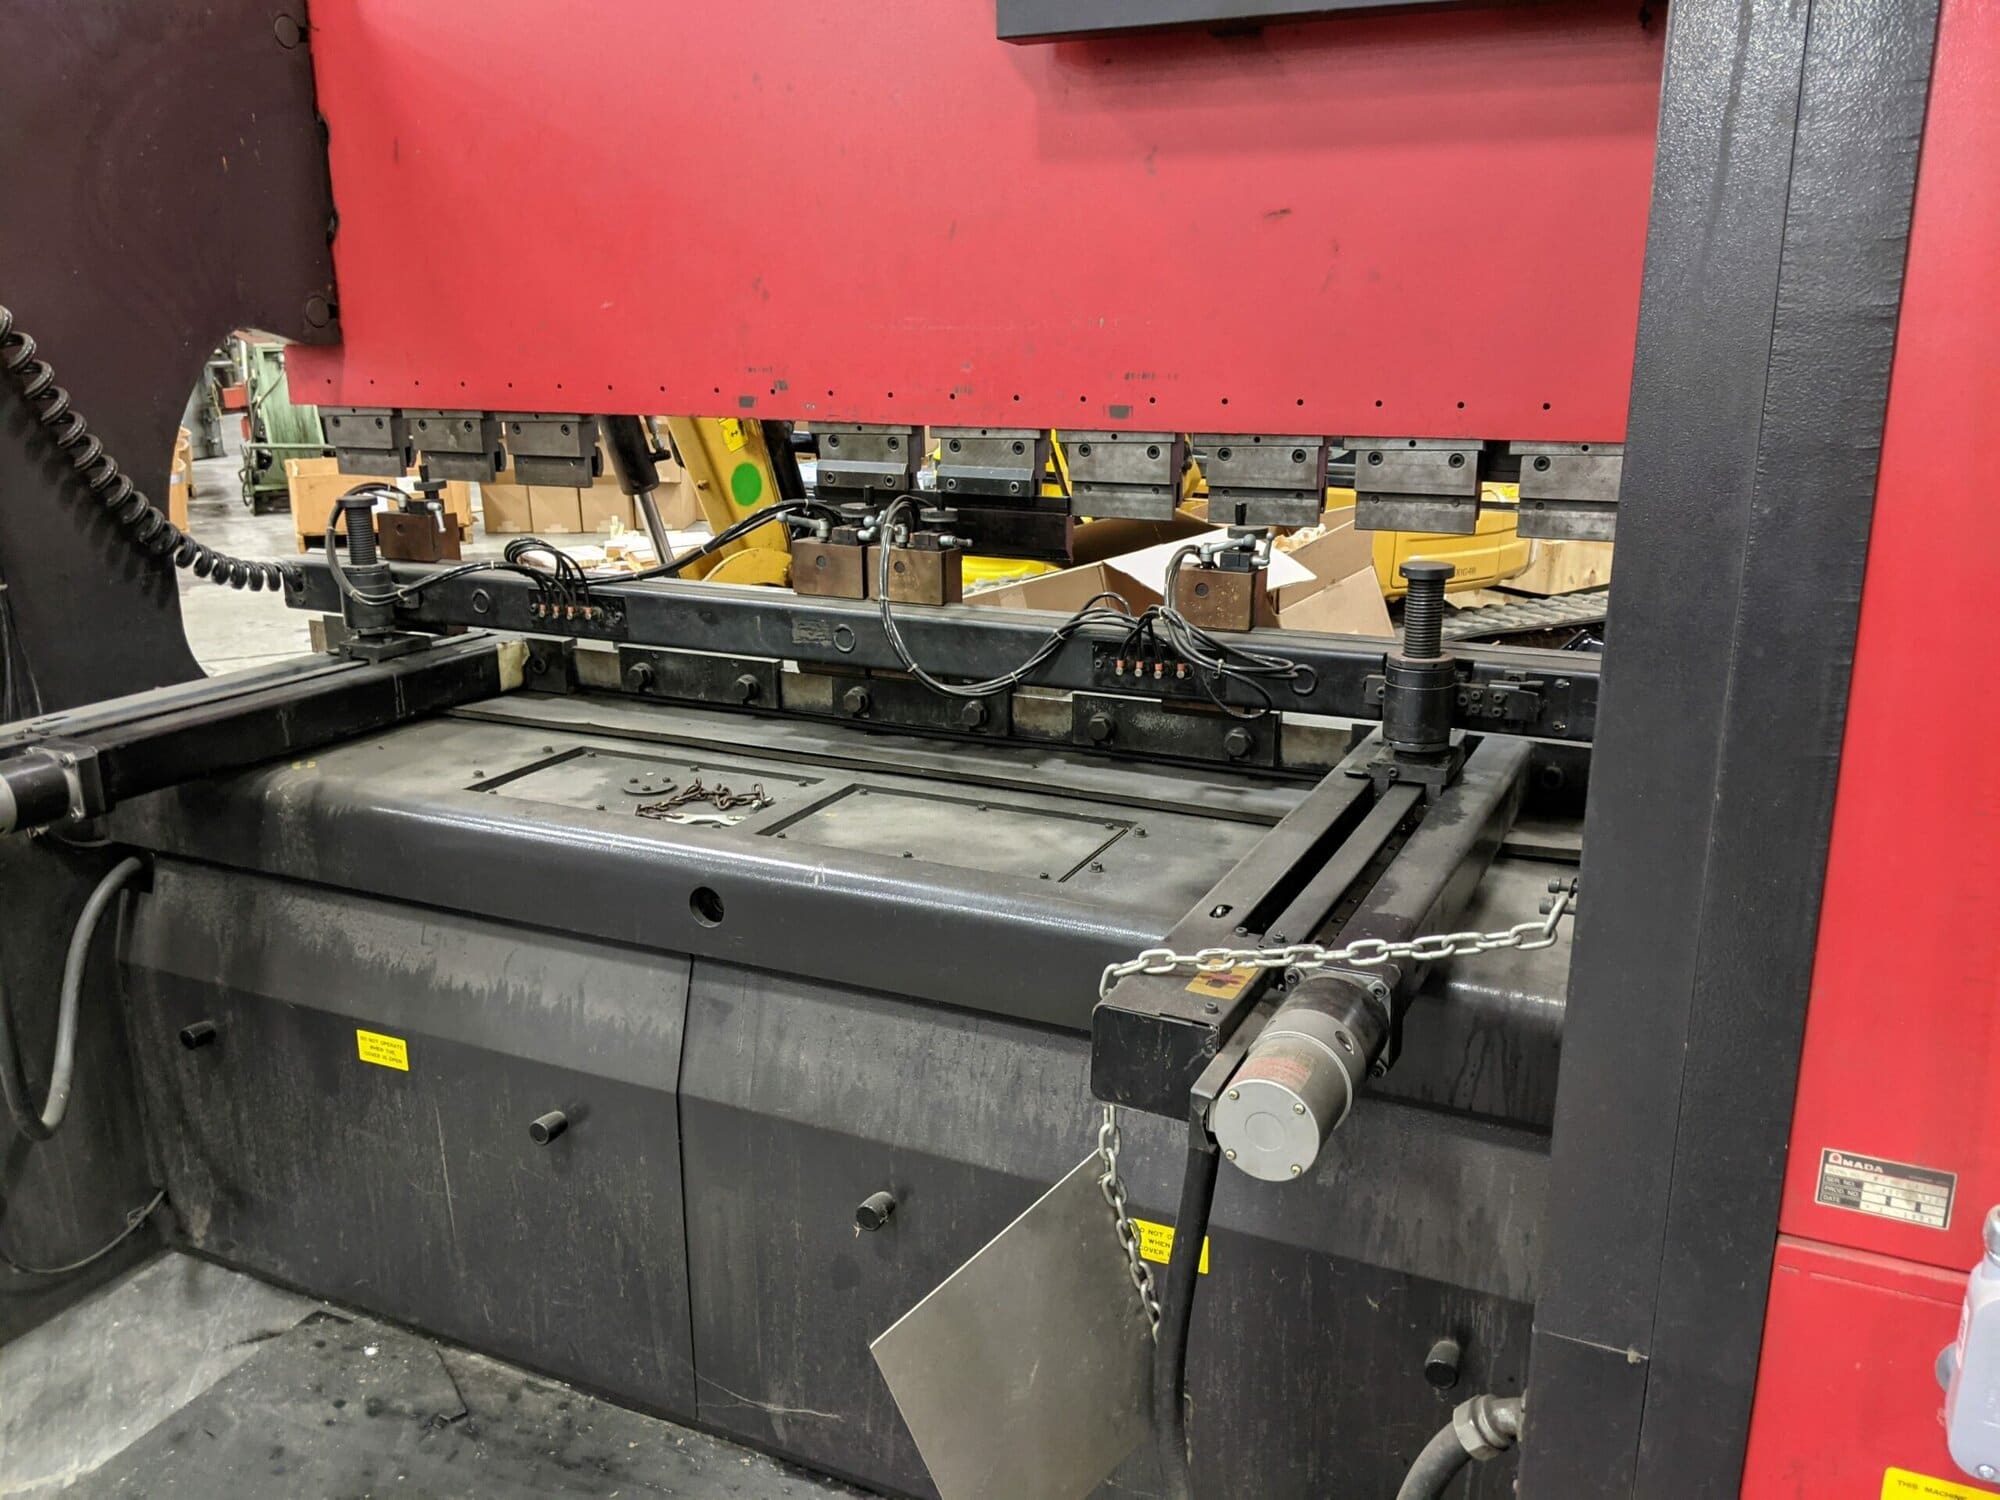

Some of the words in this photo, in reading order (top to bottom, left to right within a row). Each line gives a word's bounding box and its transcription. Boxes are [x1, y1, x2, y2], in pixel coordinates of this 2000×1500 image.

[380, 1040, 404, 1050] OPERATE
[1148, 1229, 1164, 1238] NOT
[1148, 1238, 1171, 1249] WHEN
[1897, 1479, 1919, 1490] THIS
